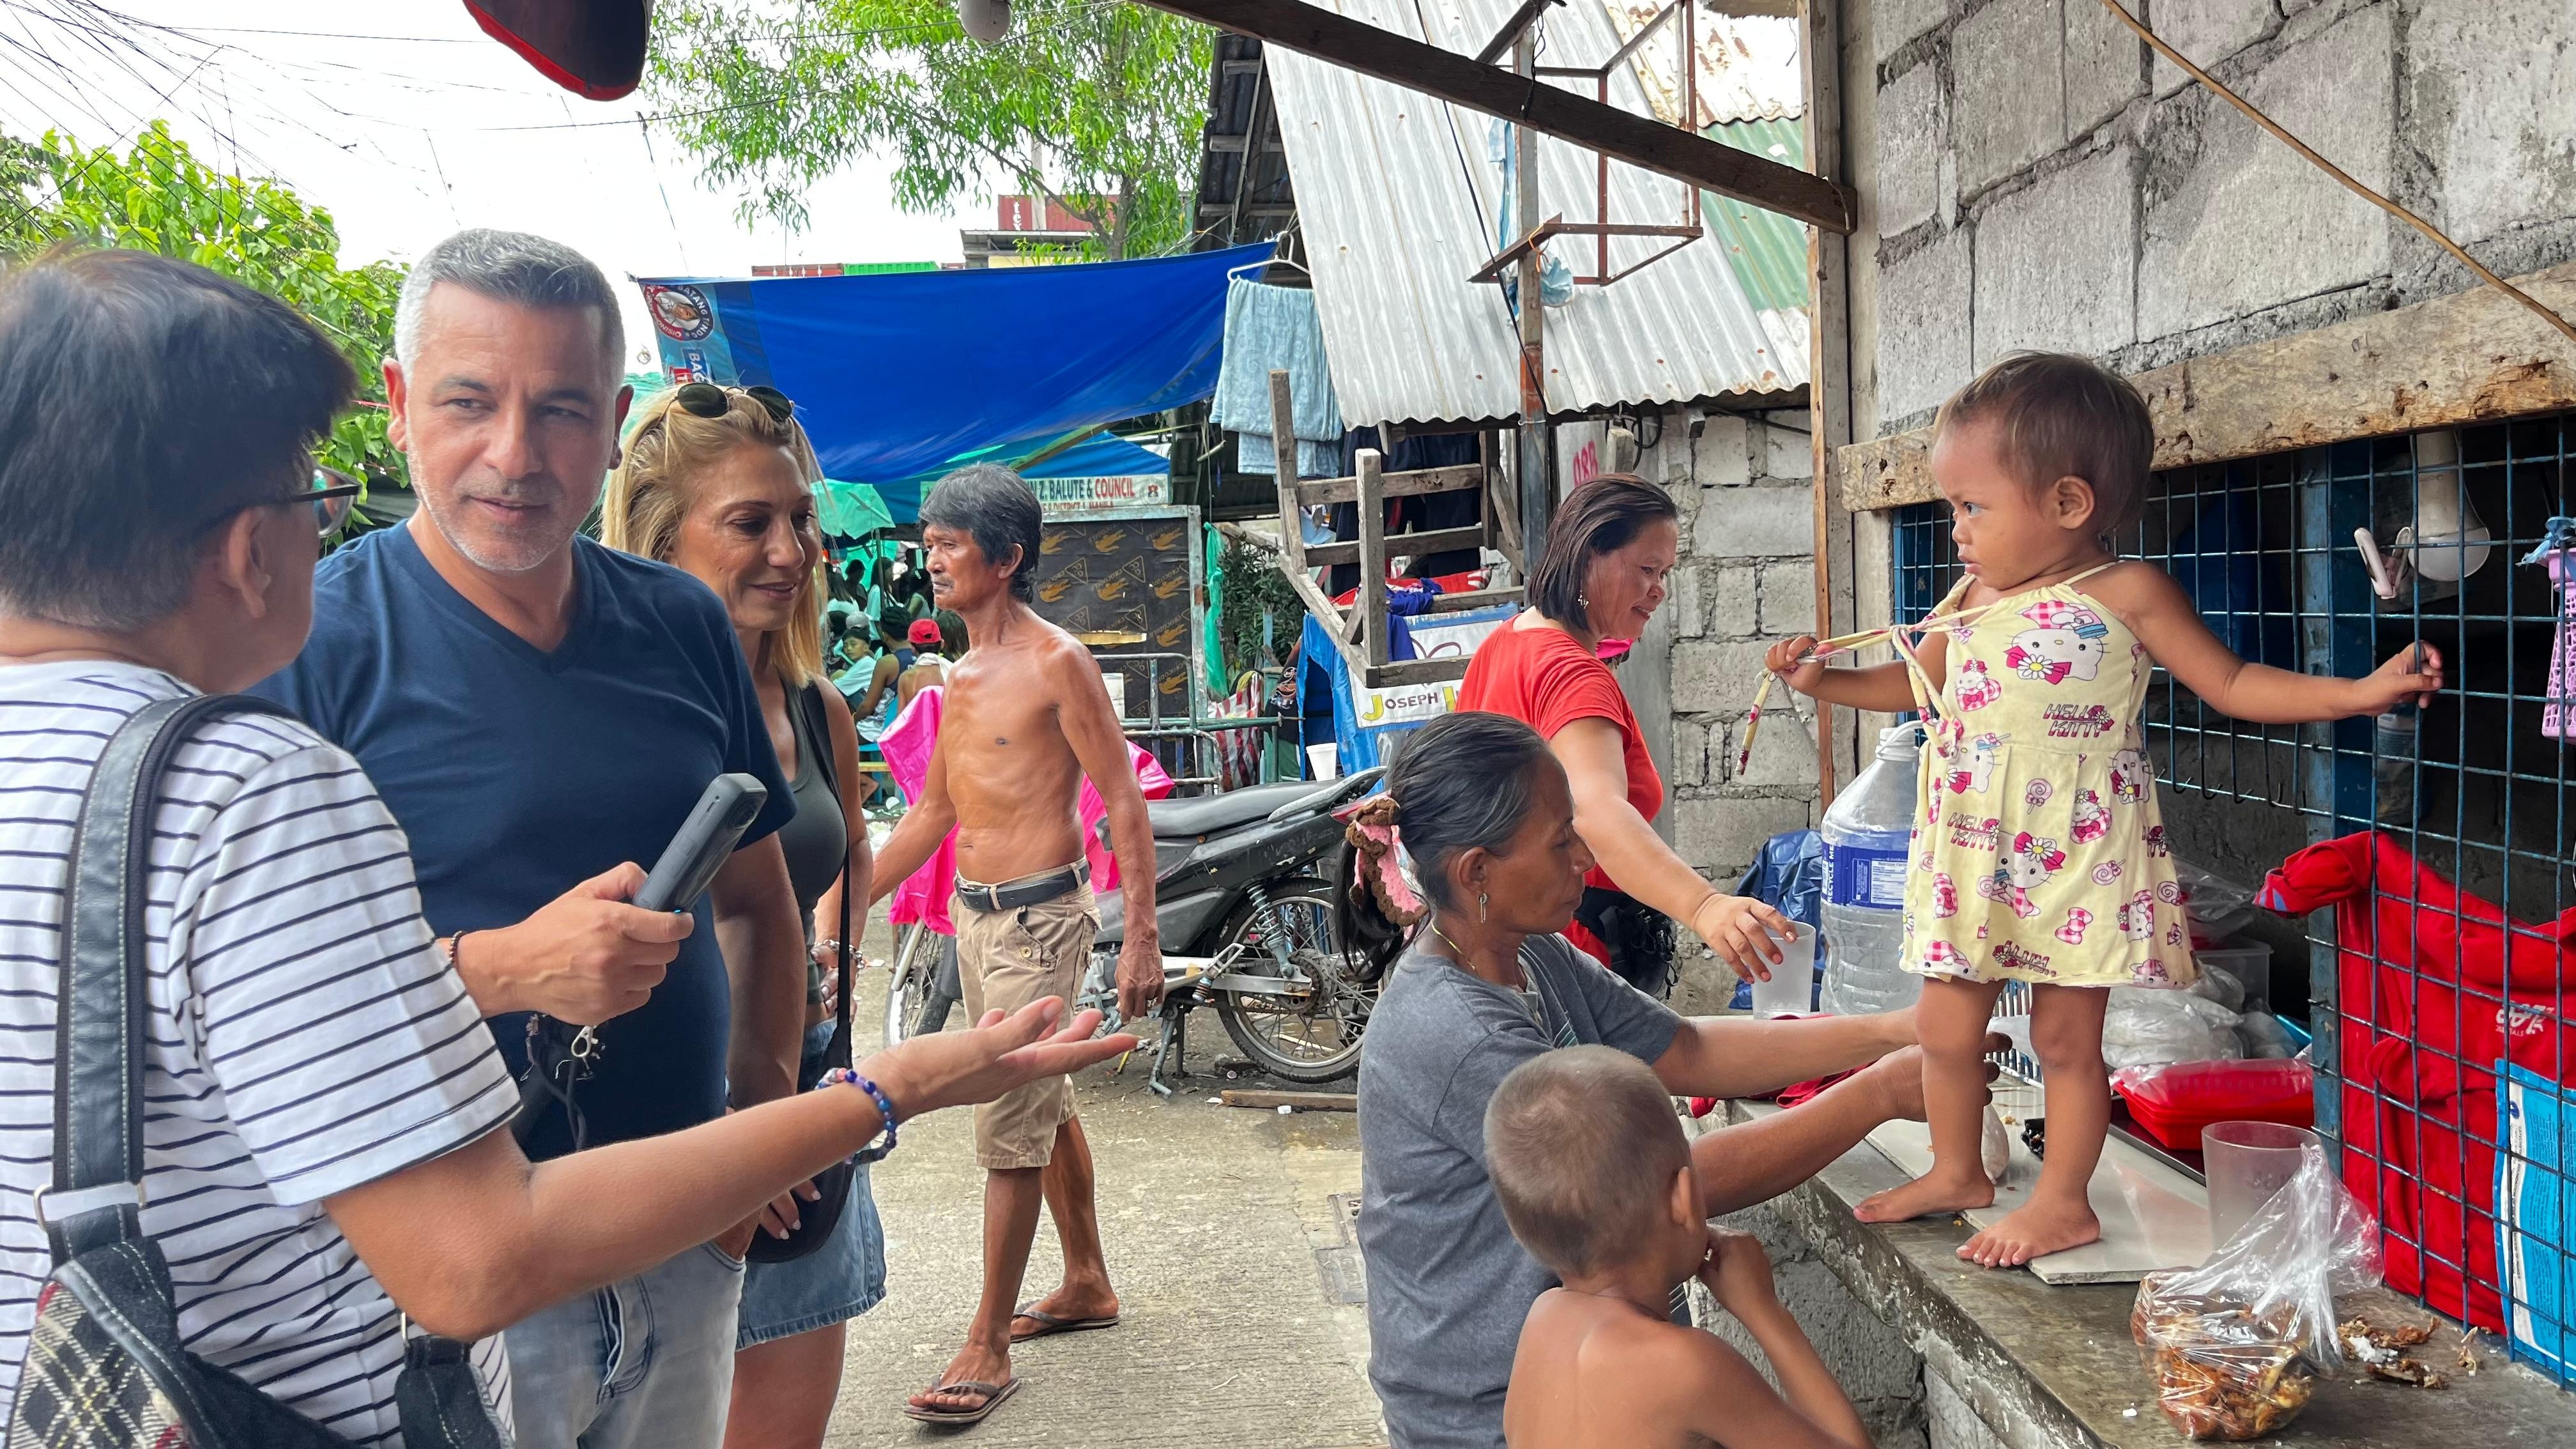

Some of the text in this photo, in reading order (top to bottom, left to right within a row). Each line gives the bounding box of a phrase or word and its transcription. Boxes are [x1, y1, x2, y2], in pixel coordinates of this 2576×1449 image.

[1049, 479, 1085, 500] BALUTE
[1087, 479, 1092, 499] &
[1095, 477, 1135, 498] COUNCIL
[1361, 692, 1438, 721] JOSEPH
[2043, 703, 2102, 721] HELL
[1947, 812, 1998, 833] HELL
[1828, 844, 1834, 860] ME
